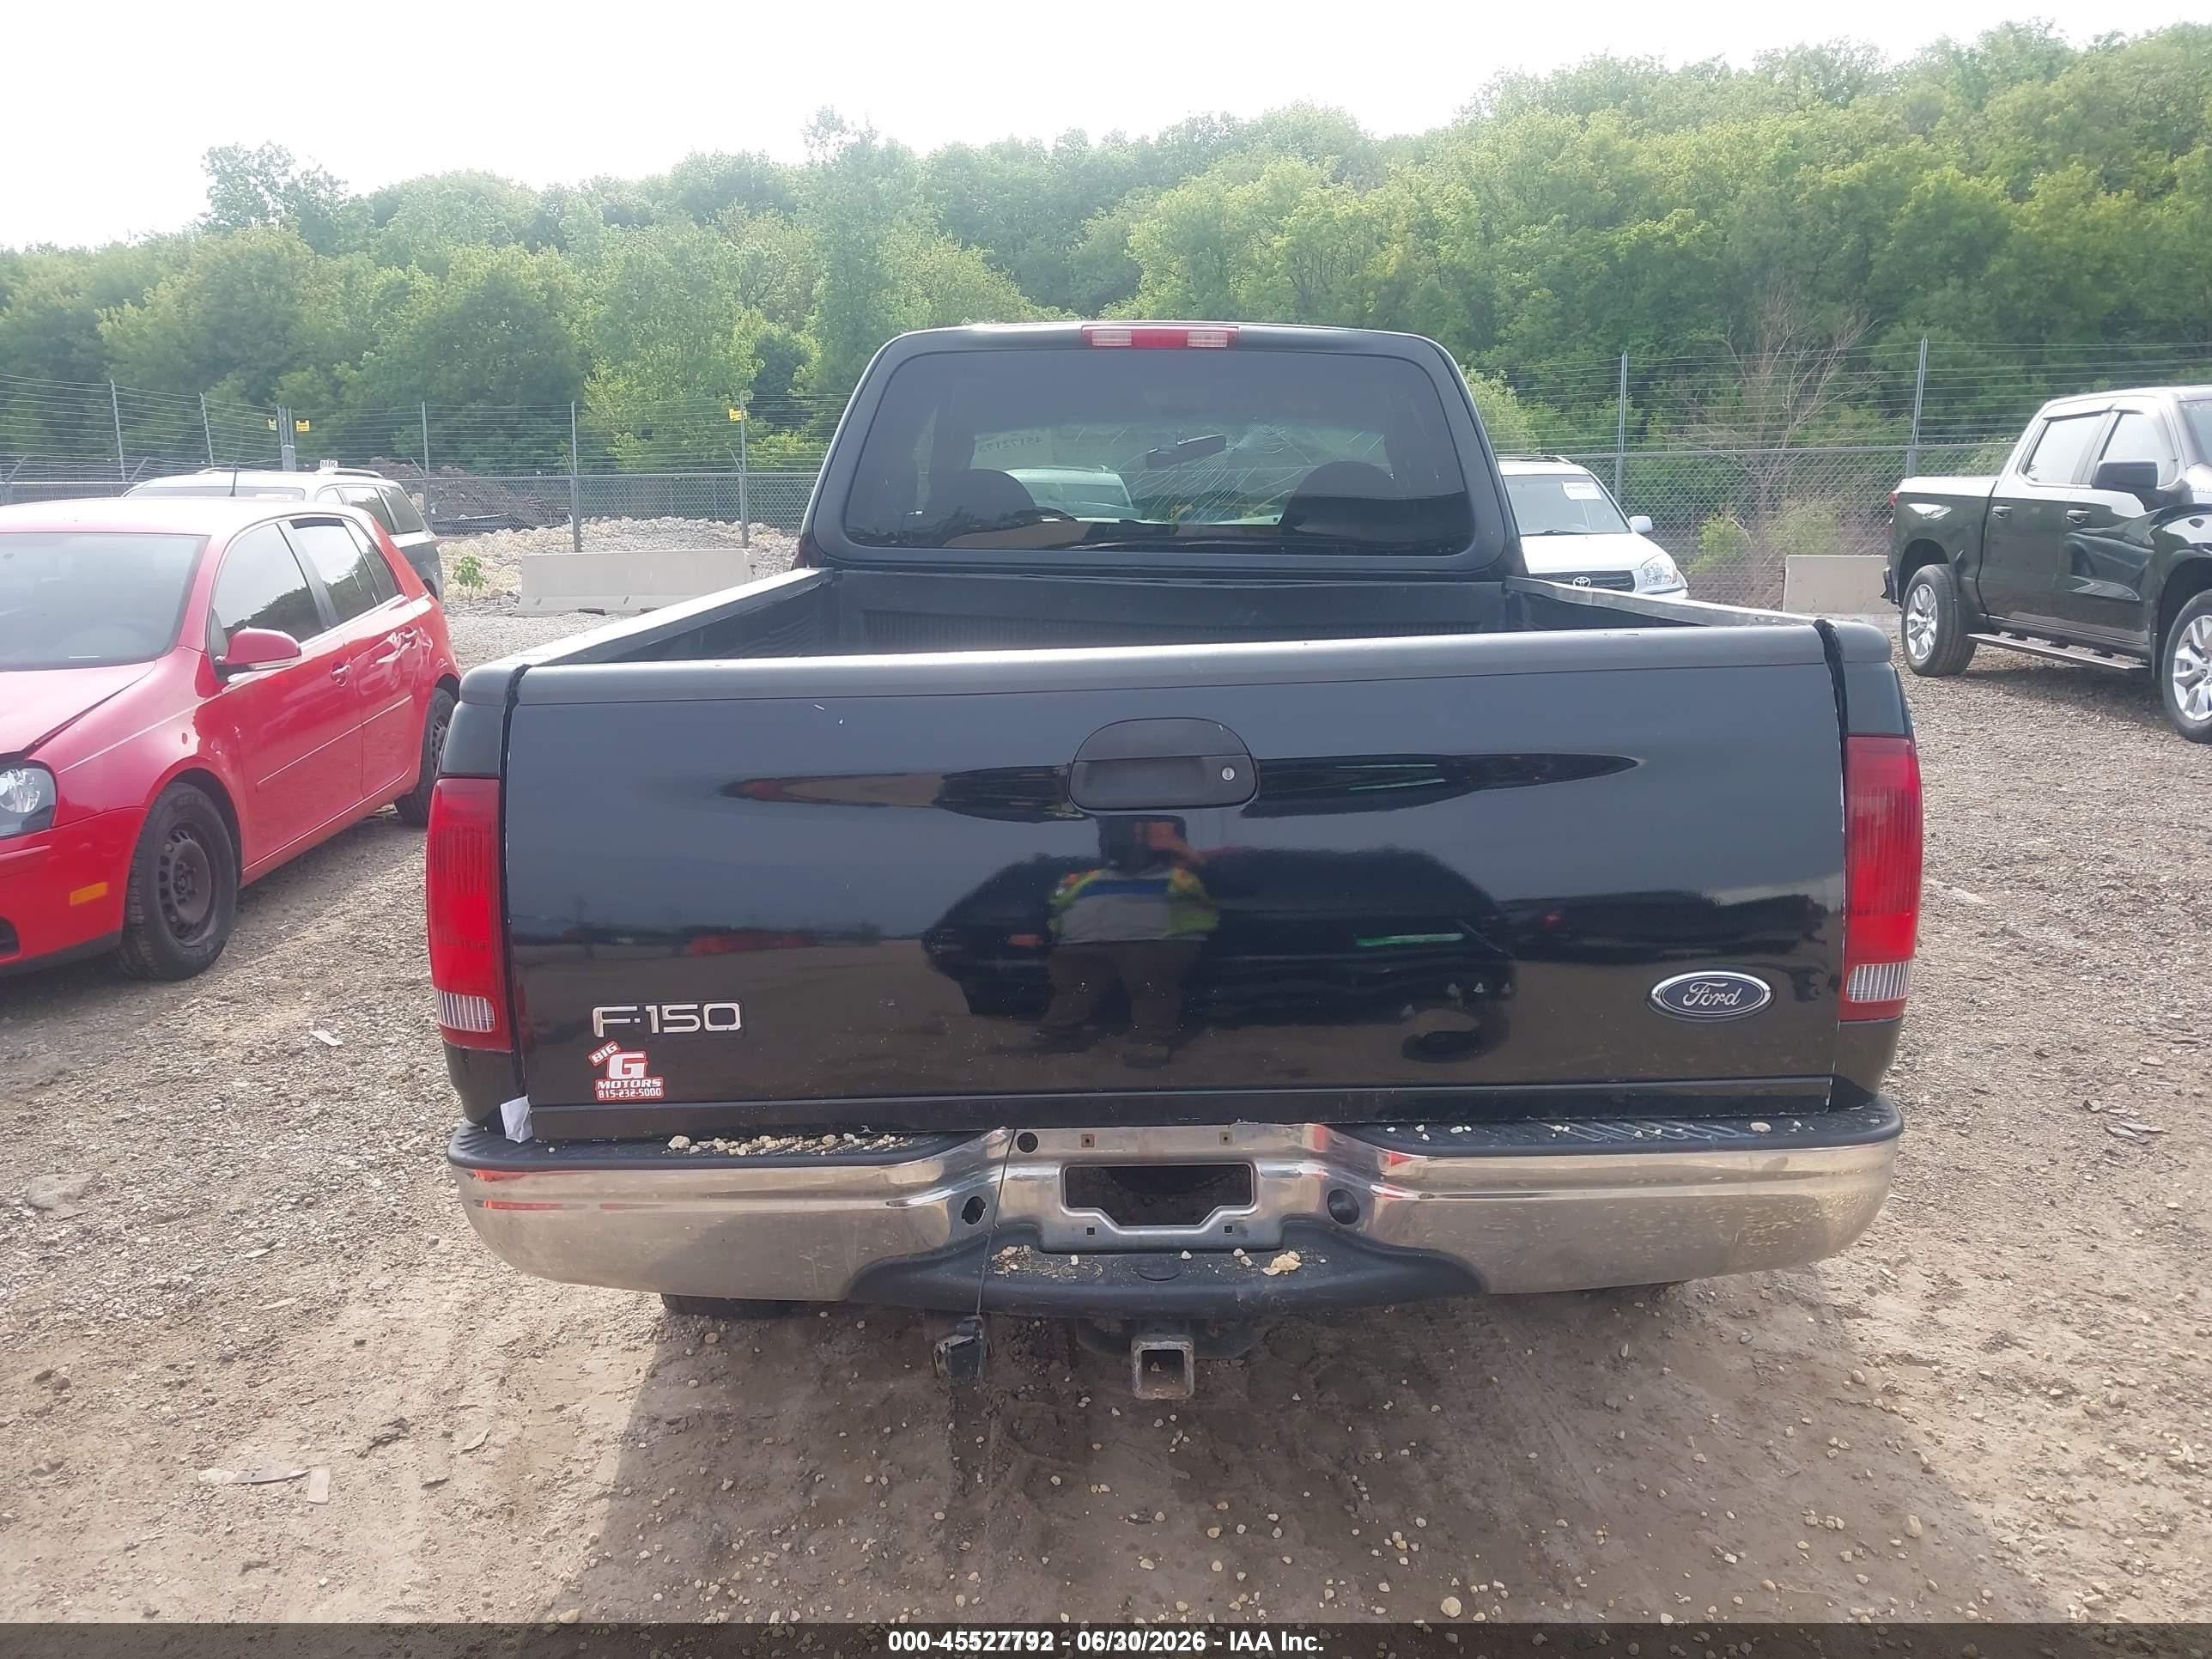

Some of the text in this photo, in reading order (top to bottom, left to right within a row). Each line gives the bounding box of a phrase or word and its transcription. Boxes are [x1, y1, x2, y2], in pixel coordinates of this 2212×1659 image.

[1683, 981, 1743, 1006] Ford
[592, 1002, 741, 1038] F-150
[591, 1042, 619, 1064] BIG
[608, 1053, 646, 1079] G
[597, 1079, 661, 1090] MOTORS
[598, 1087, 662, 1099] 815-232-5000
